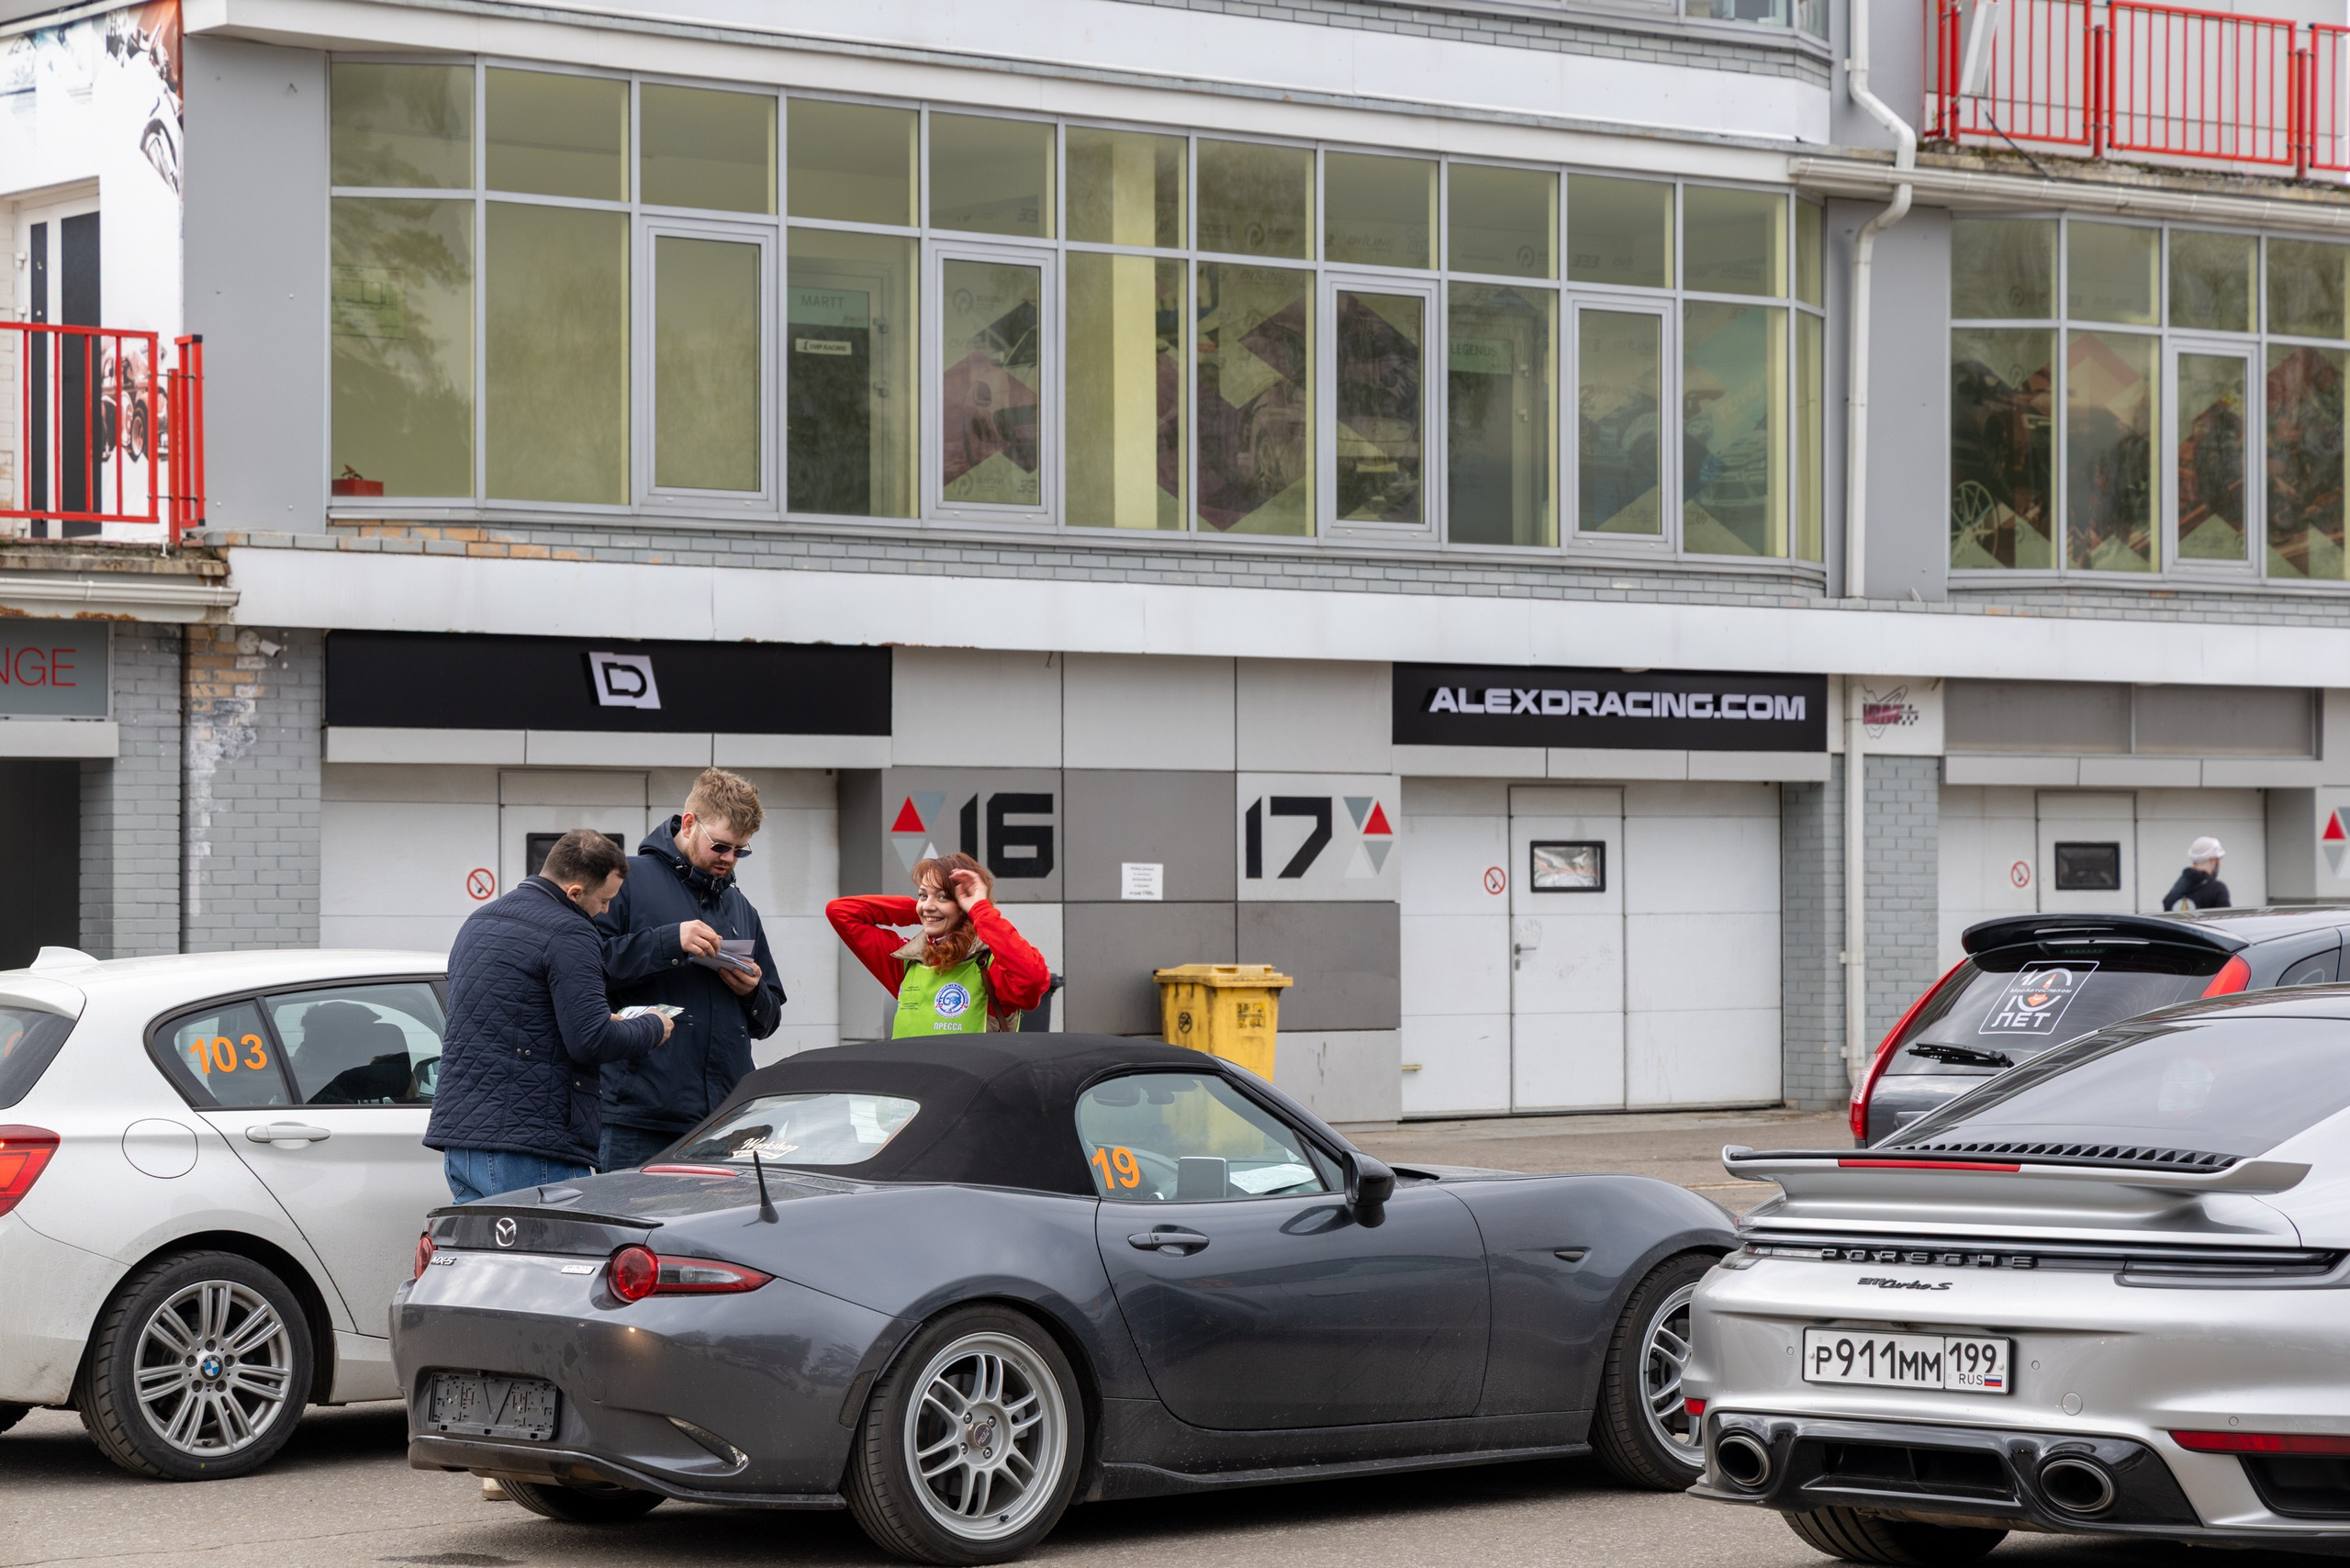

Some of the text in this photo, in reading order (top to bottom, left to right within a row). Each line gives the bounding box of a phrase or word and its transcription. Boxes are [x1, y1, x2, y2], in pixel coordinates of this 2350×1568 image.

[800, 294, 845, 308] MARTT
[1450, 343, 1497, 357] LEGENDS
[1429, 687, 1806, 721] ALEXDRACING.COM
[959, 792, 1054, 879] 16
[1246, 796, 1333, 879] 17
[934, 1022, 963, 1031] ПРЕССА
[1990, 1012, 2052, 1028] ЛЕТ
[189, 1034, 268, 1075] 103
[740, 1136, 800, 1152] Workshop
[1091, 1147, 1140, 1190] 19
[431, 1256, 457, 1266] MX-5
[1821, 1248, 2035, 1270] PORSCHE
[1948, 1341, 1998, 1373] 199
[1958, 1372, 1984, 1385] RUS
